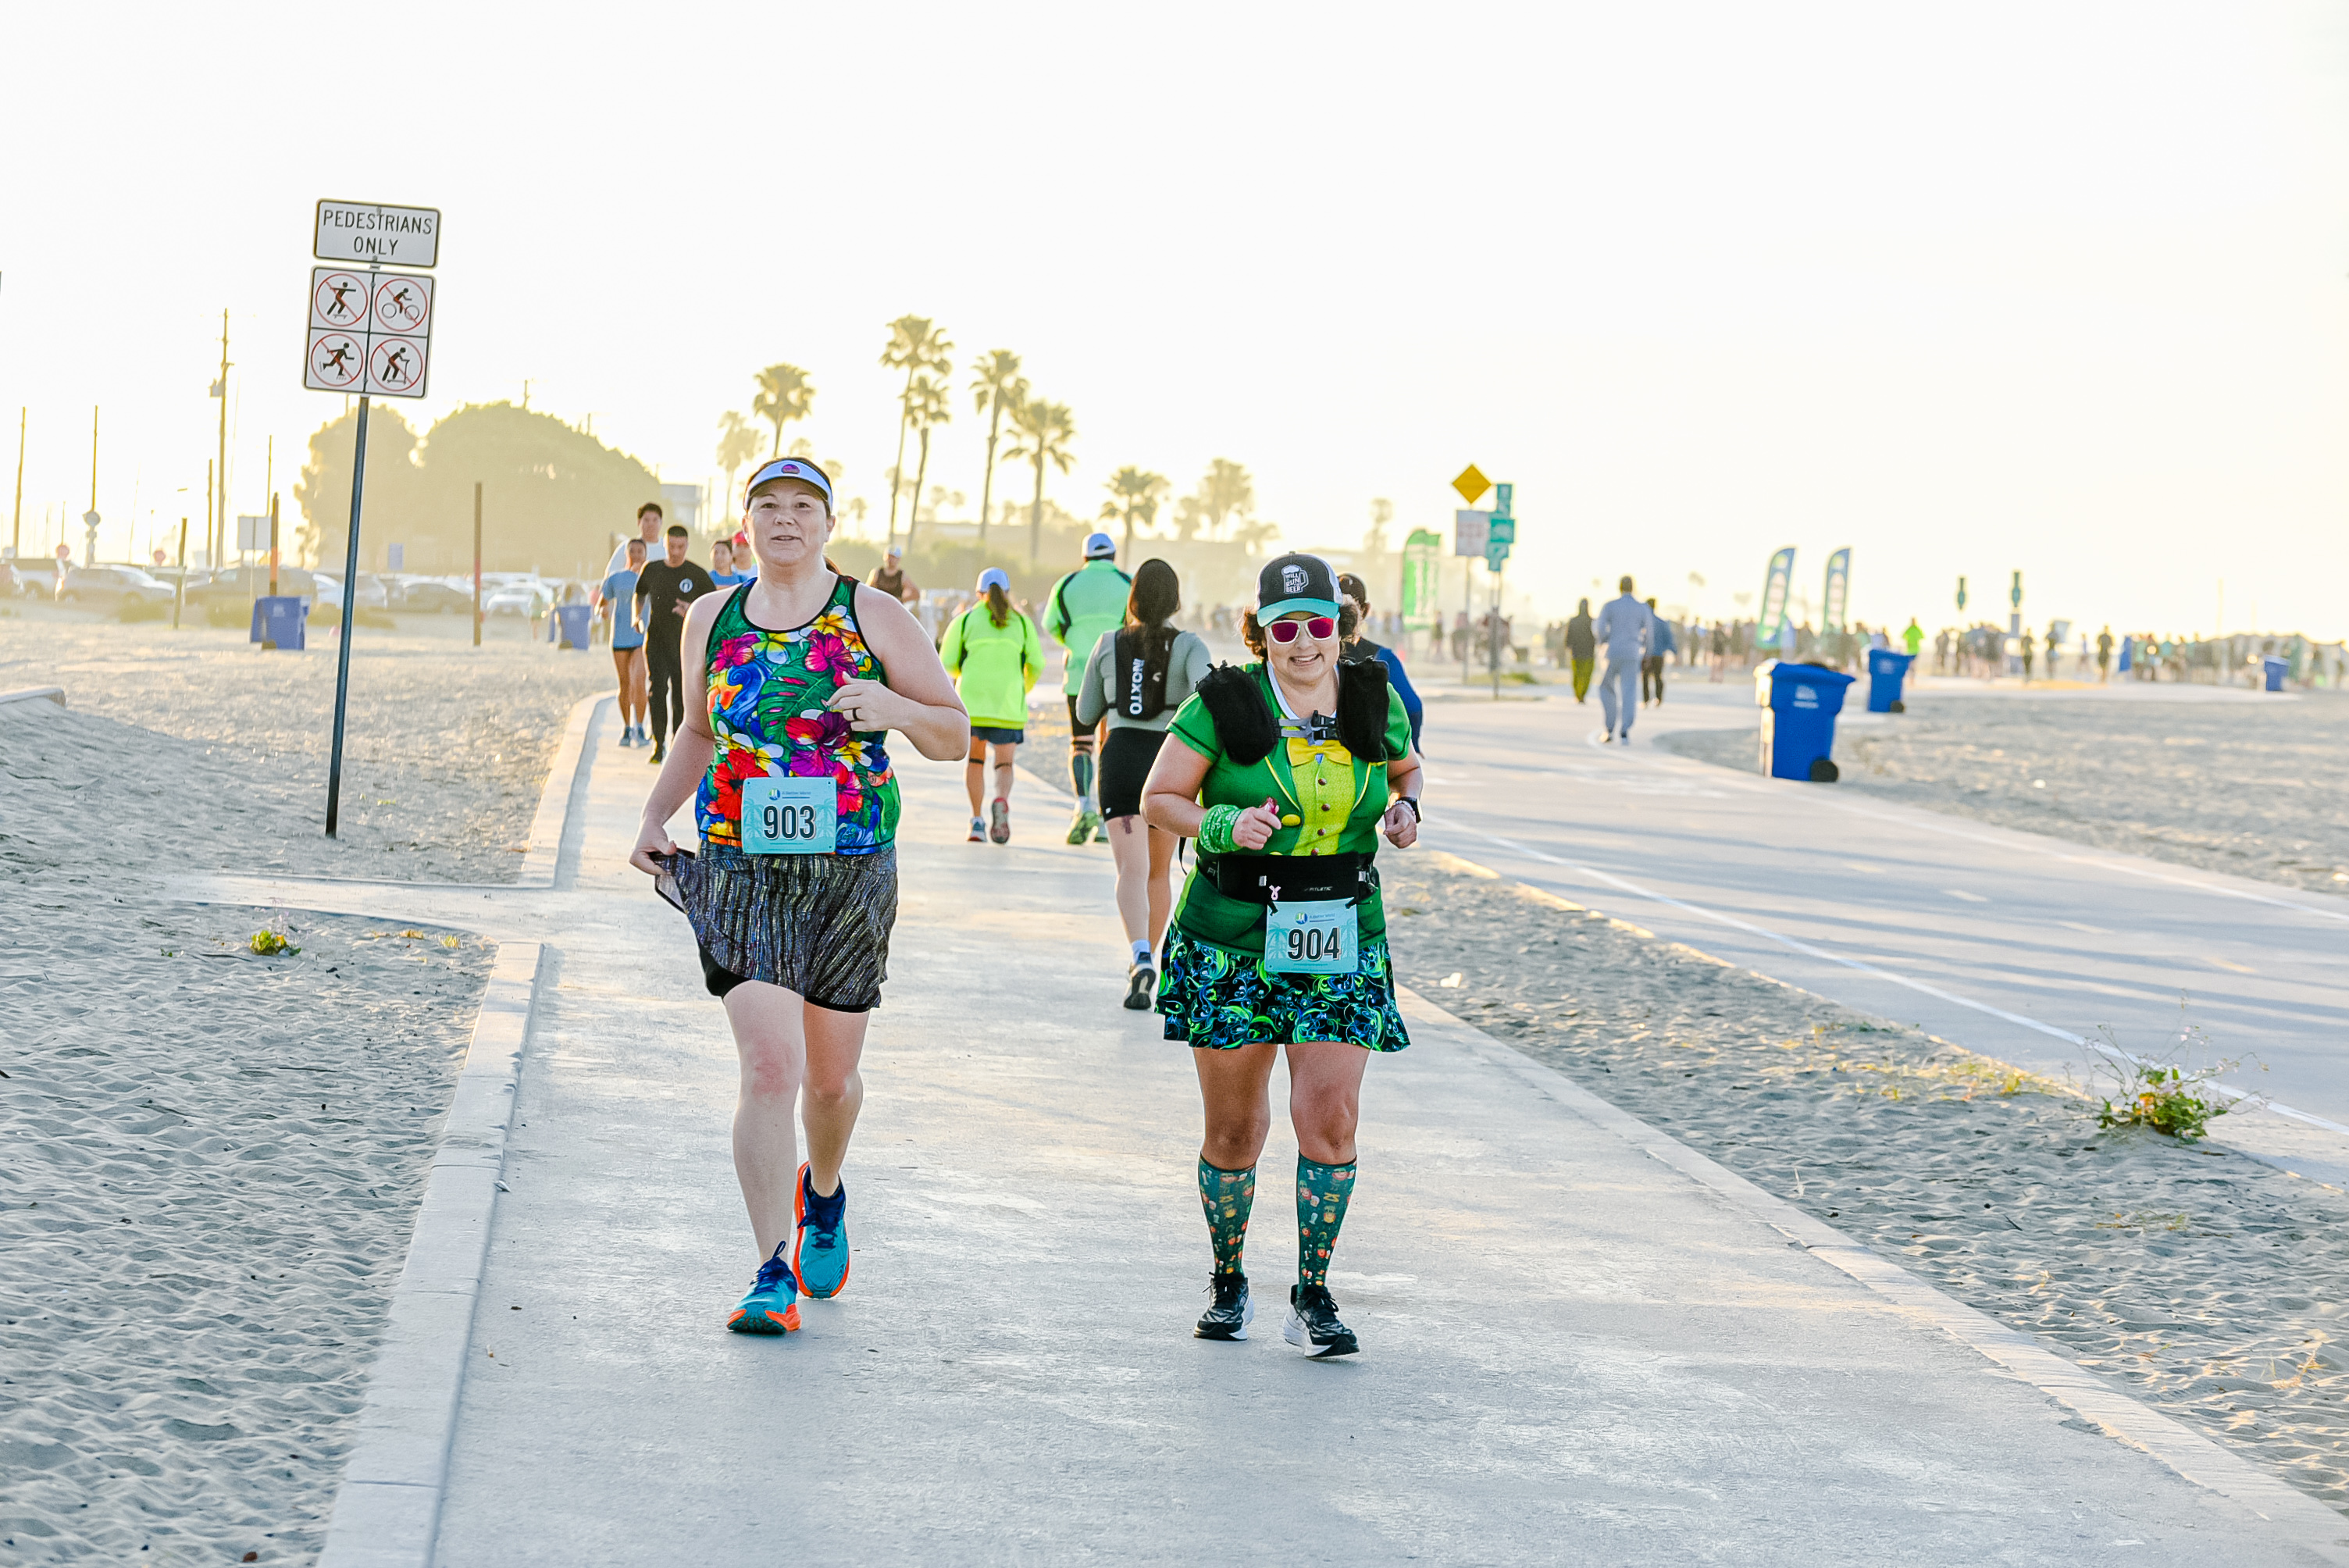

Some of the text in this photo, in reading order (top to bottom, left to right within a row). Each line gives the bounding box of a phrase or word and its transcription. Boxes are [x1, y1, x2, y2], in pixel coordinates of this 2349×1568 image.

[323, 209, 433, 235] PEDESTRIANS
[354, 236, 399, 255] ONLY
[1285, 577, 1299, 586] RUN
[763, 805, 816, 839] 903
[1288, 927, 1341, 960] 904
